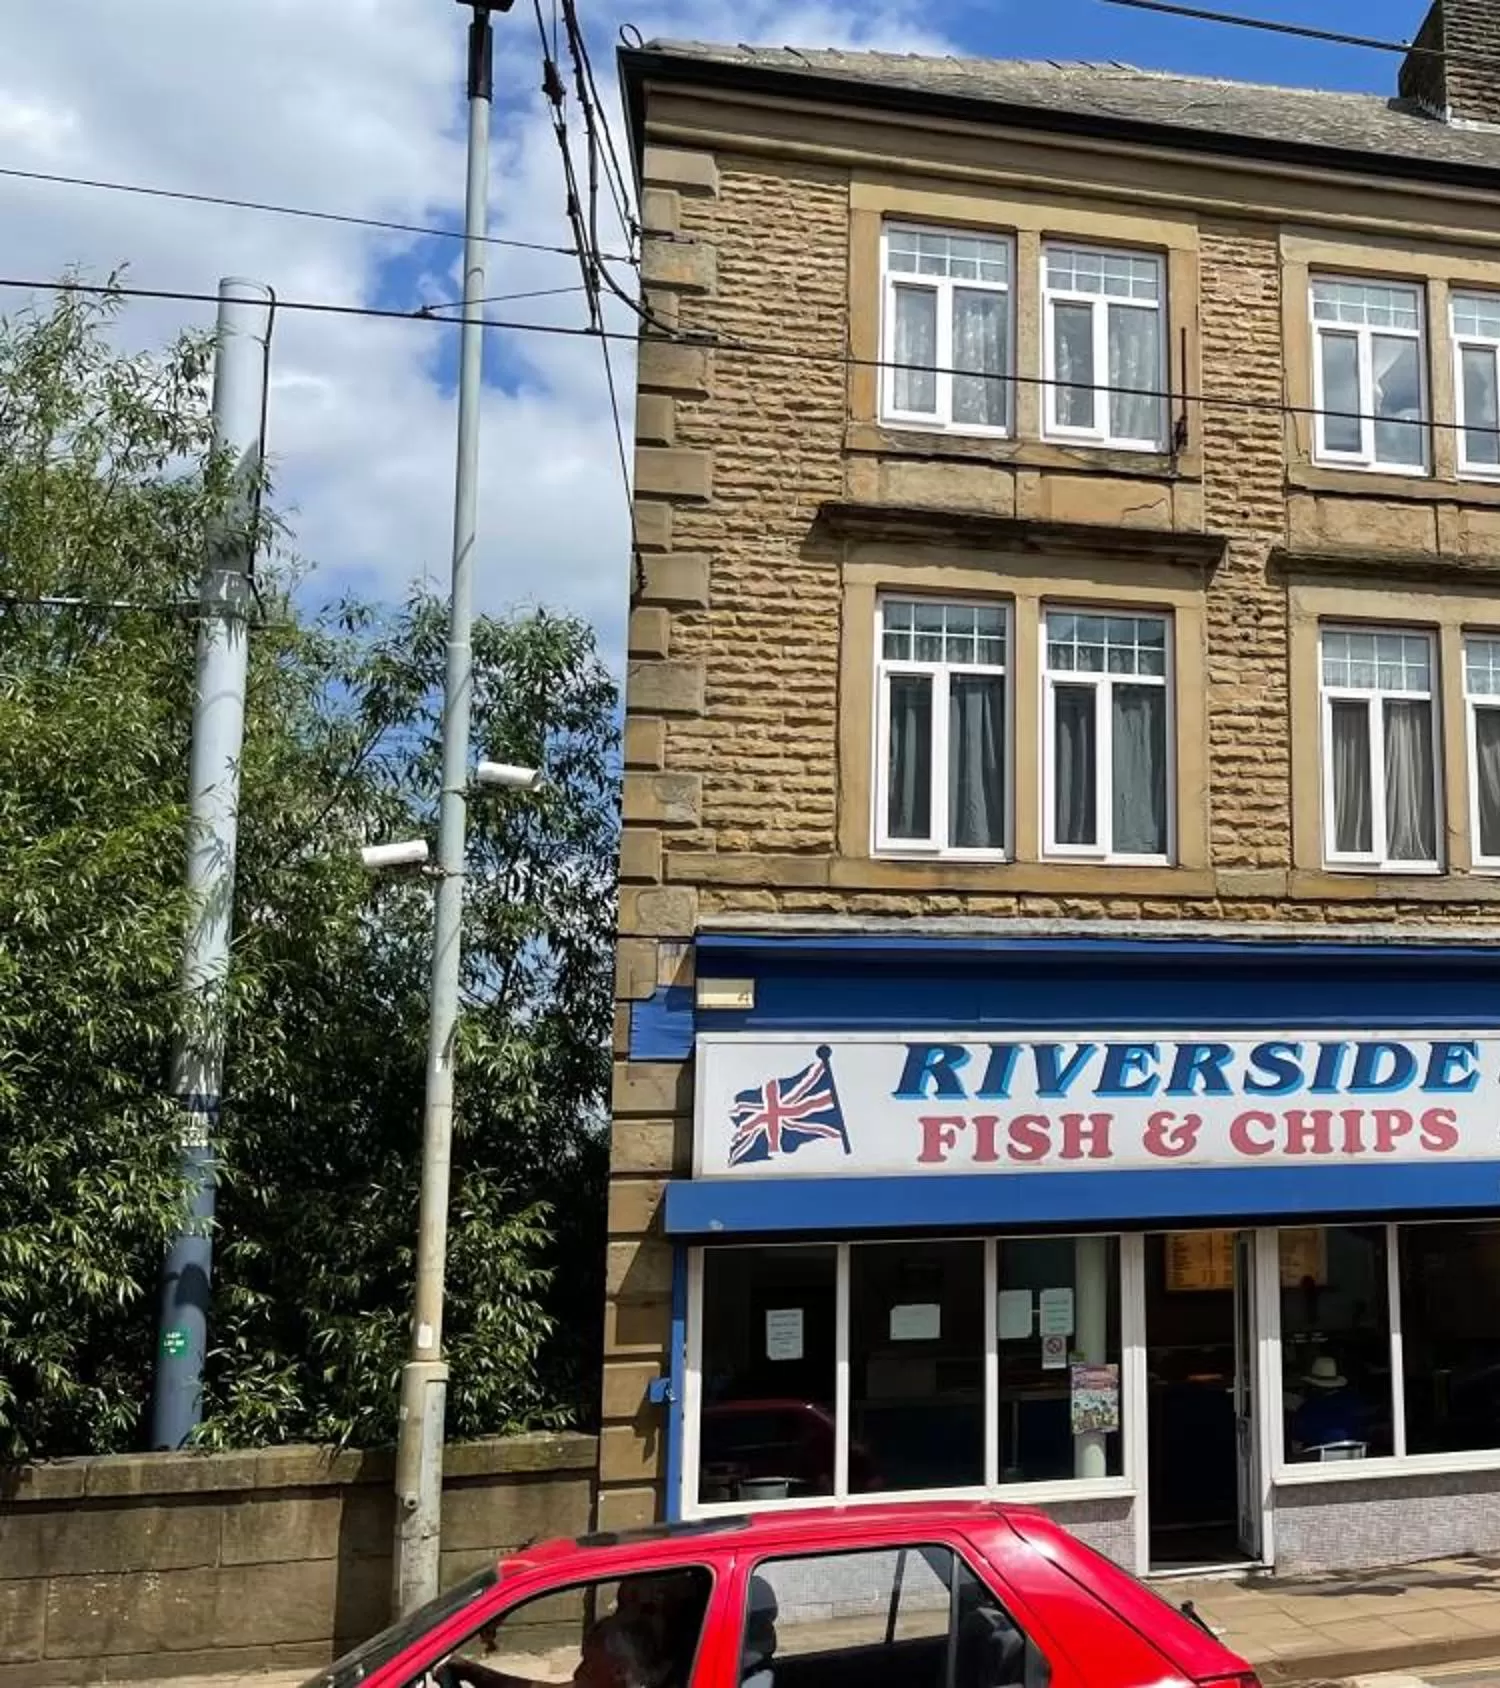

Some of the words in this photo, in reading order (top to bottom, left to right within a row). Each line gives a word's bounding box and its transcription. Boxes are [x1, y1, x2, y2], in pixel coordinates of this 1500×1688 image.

[892, 1041, 1480, 1100] RIVERSIDE
[917, 1113, 1114, 1162] FISH
[1142, 1111, 1203, 1158] &
[1229, 1107, 1459, 1156] CHIPS
